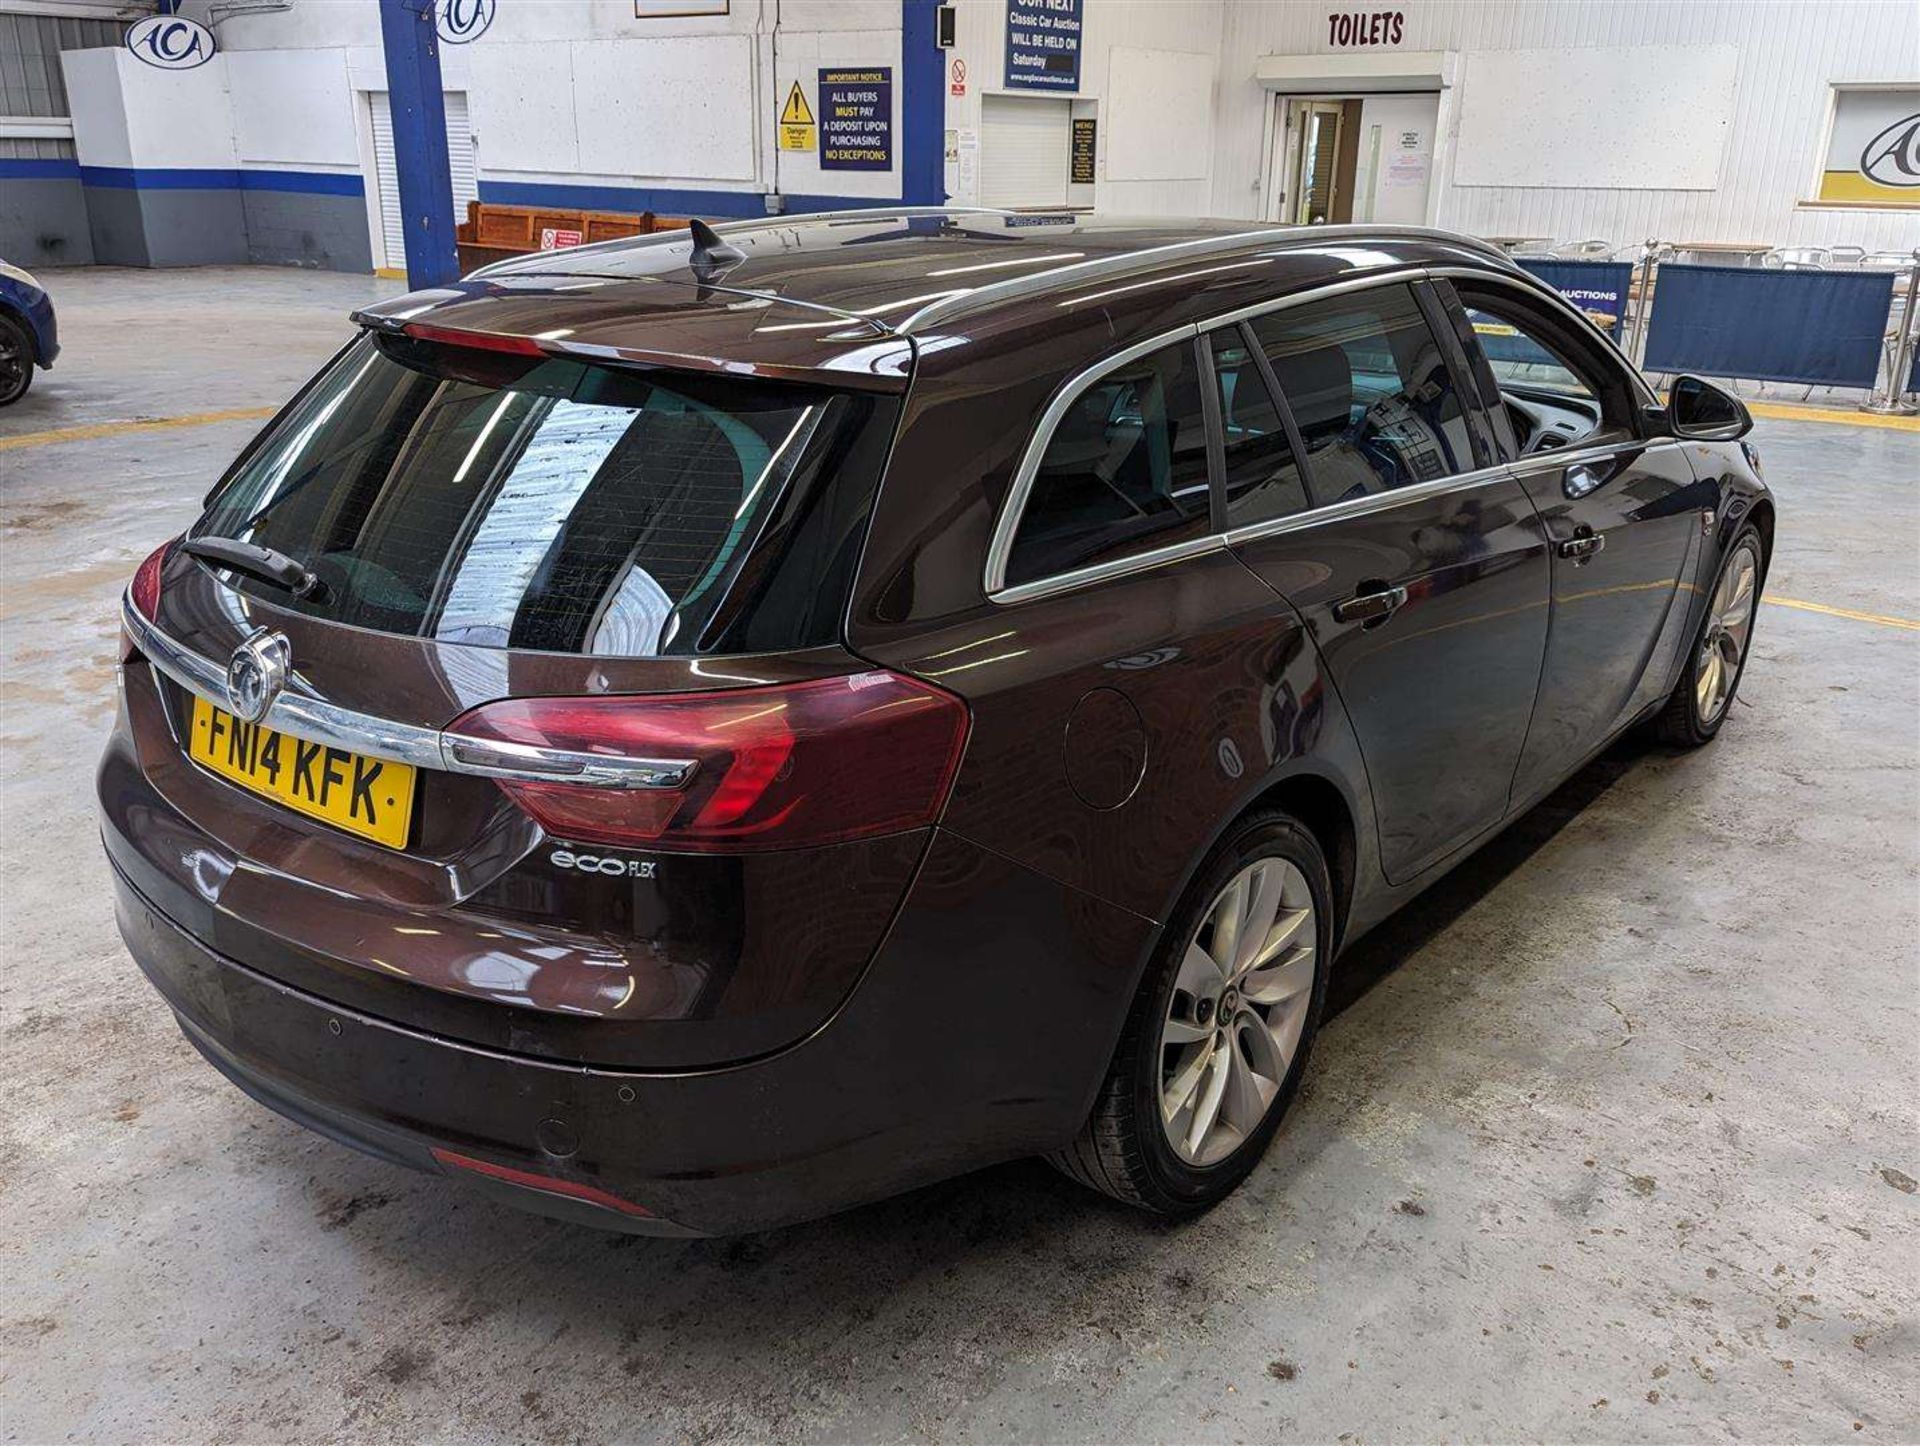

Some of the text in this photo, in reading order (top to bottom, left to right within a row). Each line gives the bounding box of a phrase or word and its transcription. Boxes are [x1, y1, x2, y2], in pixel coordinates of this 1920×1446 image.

[1010, 11, 1080, 31] Classic Car Auction
[1328, 12, 1404, 47] TOILETS
[134, 22, 204, 61] ACA
[1011, 32, 1077, 50] WILL BE HELD ON
[1012, 52, 1046, 70] Saturday
[826, 73, 883, 81] IMPORTANT NOTICE
[832, 91, 878, 102] ALL BUYERS
[835, 107, 875, 117] MUST PAY
[823, 121, 888, 131] A DEPOSIT UPON
[829, 135, 881, 146] PURCHASING
[825, 150, 886, 160] NO EXCEPTIONS
[1560, 289, 1617, 301] AUCTIONS
[209, 706, 384, 826] FN14 KFK
